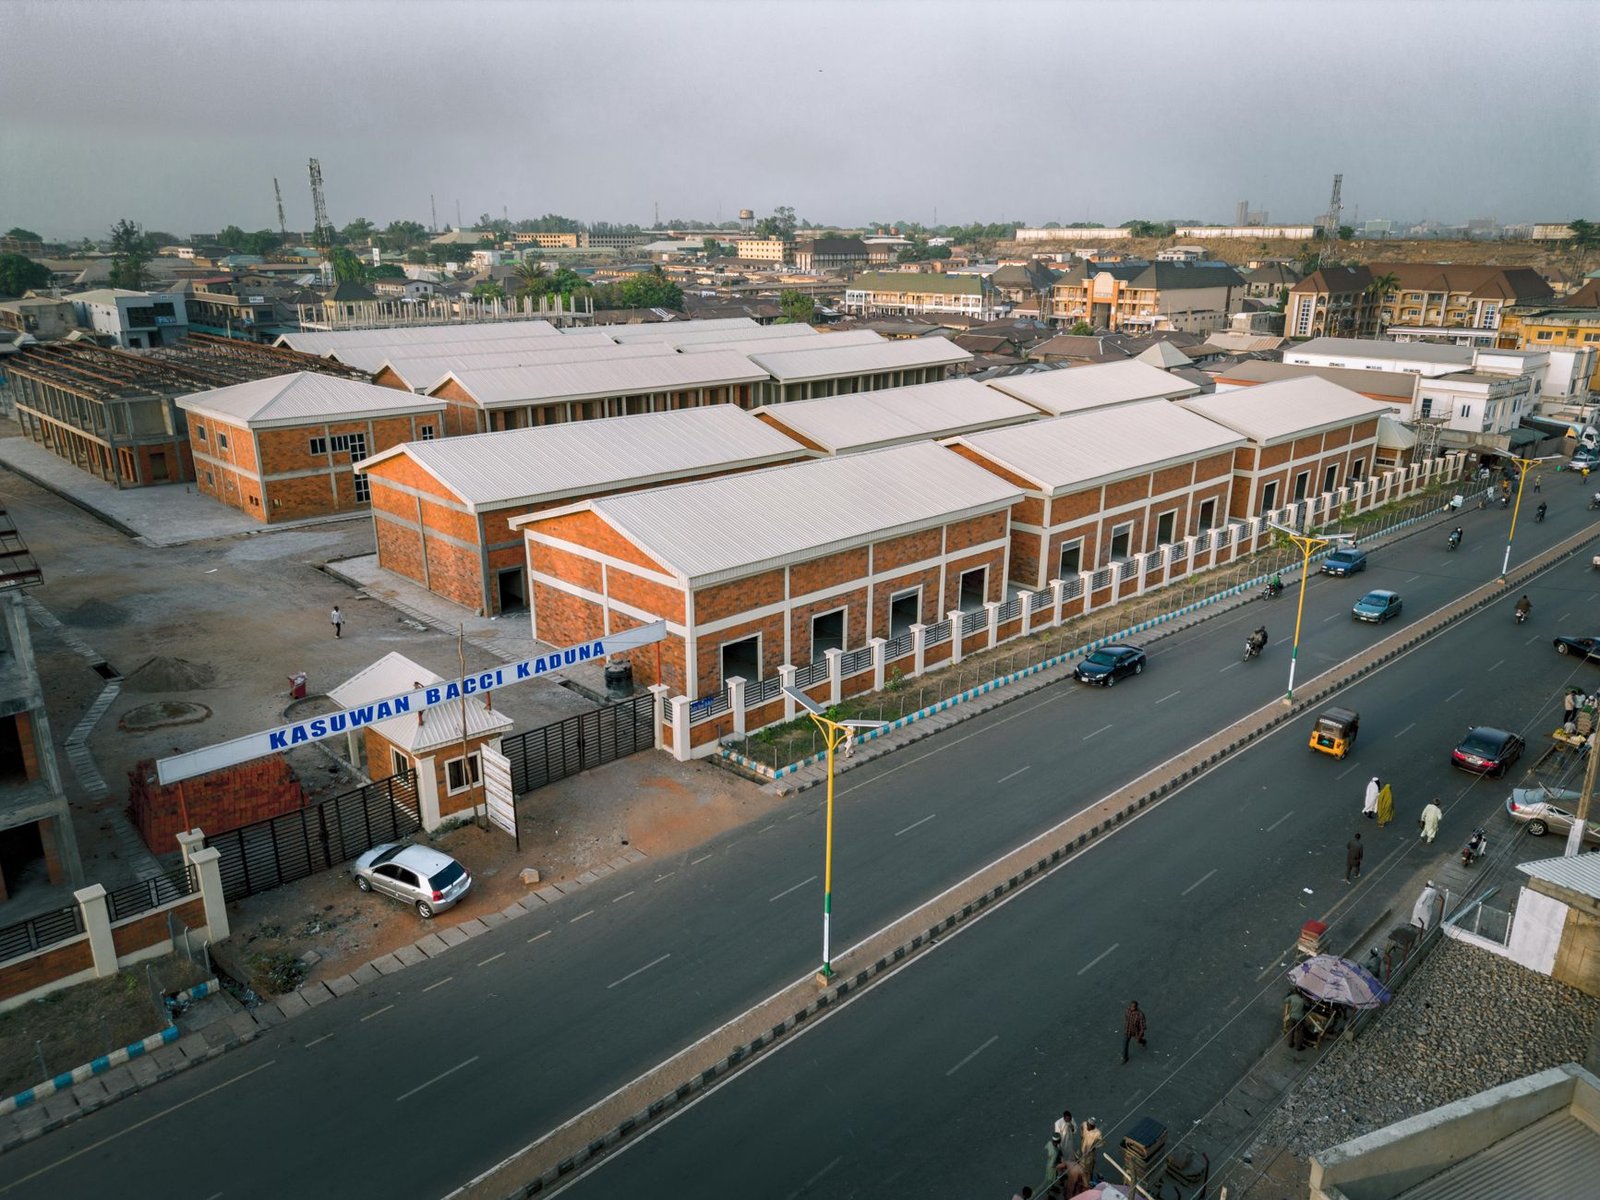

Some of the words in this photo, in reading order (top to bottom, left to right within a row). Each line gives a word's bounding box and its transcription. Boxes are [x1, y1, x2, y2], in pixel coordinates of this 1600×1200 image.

[268, 695, 410, 750] KASUWAN
[425, 669, 503, 706] BACCI
[517, 641, 605, 680] KADUNA
